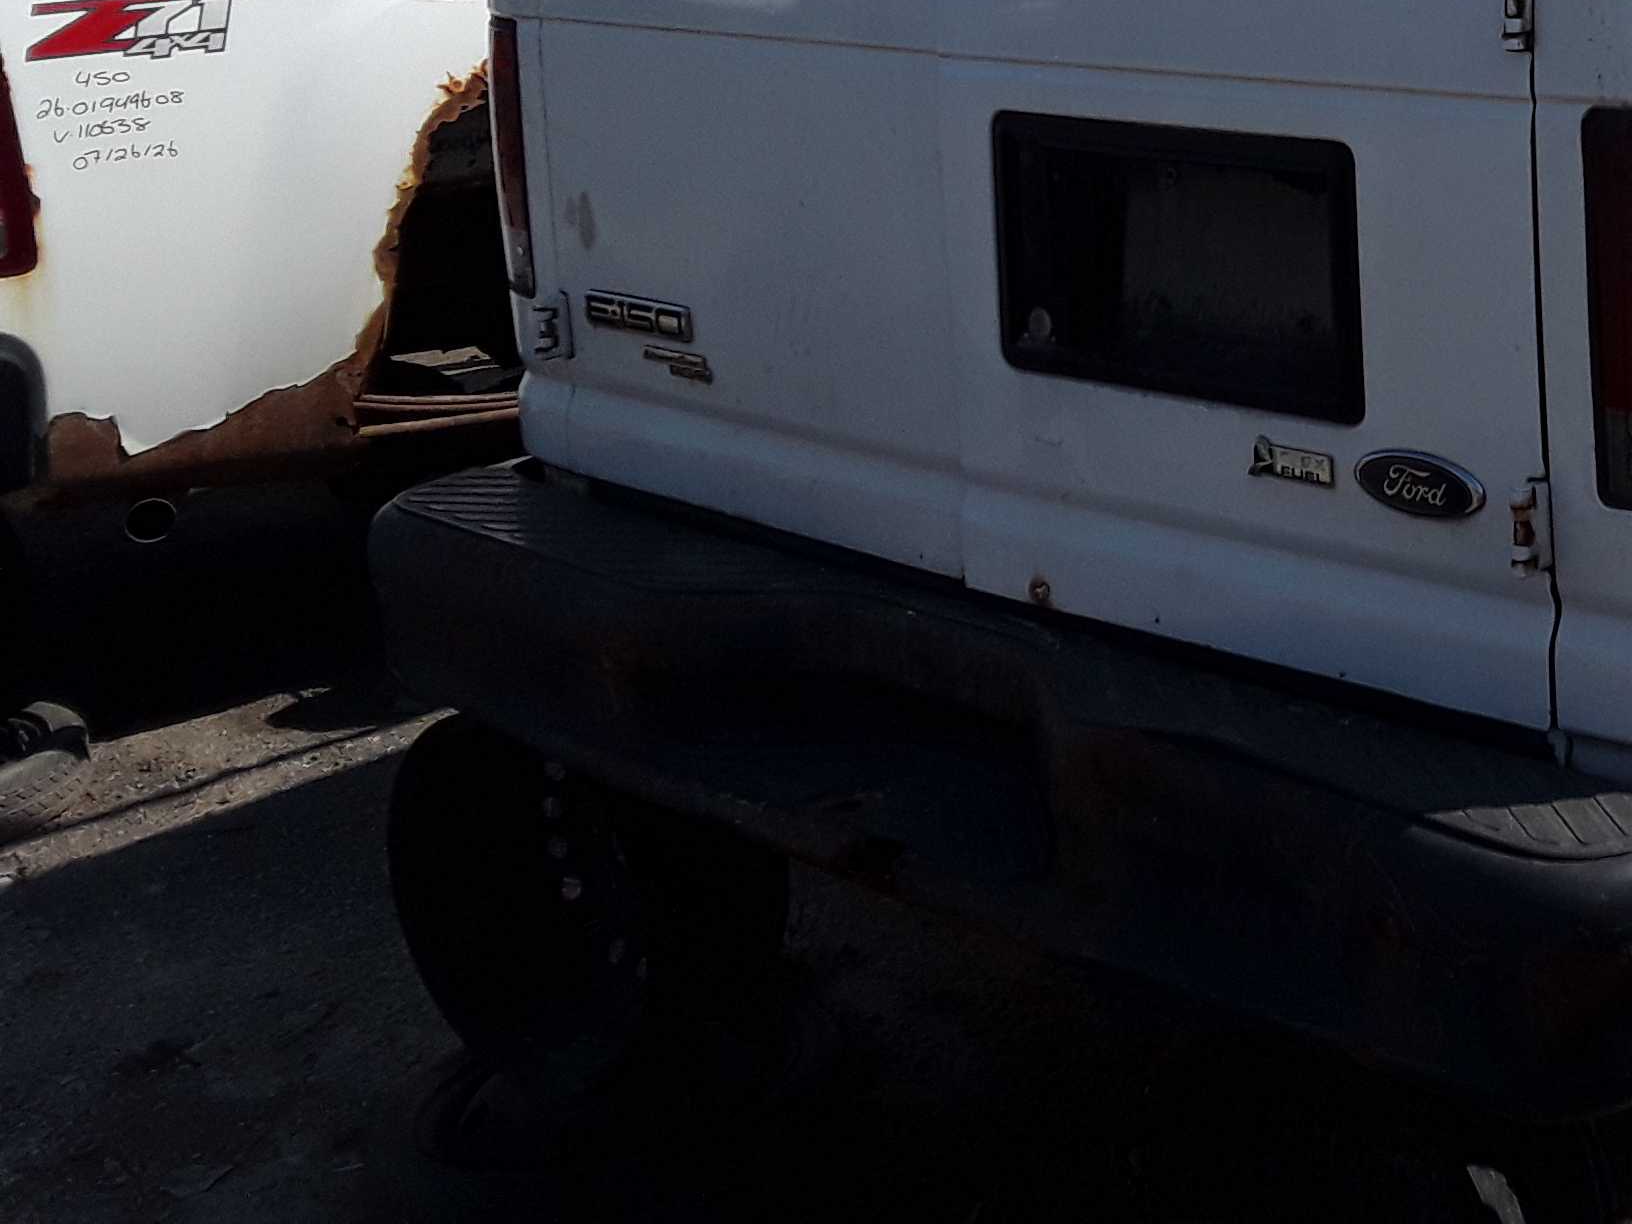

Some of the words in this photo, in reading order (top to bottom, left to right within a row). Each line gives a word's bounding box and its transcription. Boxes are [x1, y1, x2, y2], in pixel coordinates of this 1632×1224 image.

[75, 71, 131, 87] 450
[72, 140, 179, 170] 07/26/26
[1382, 463, 1448, 507] Ford
